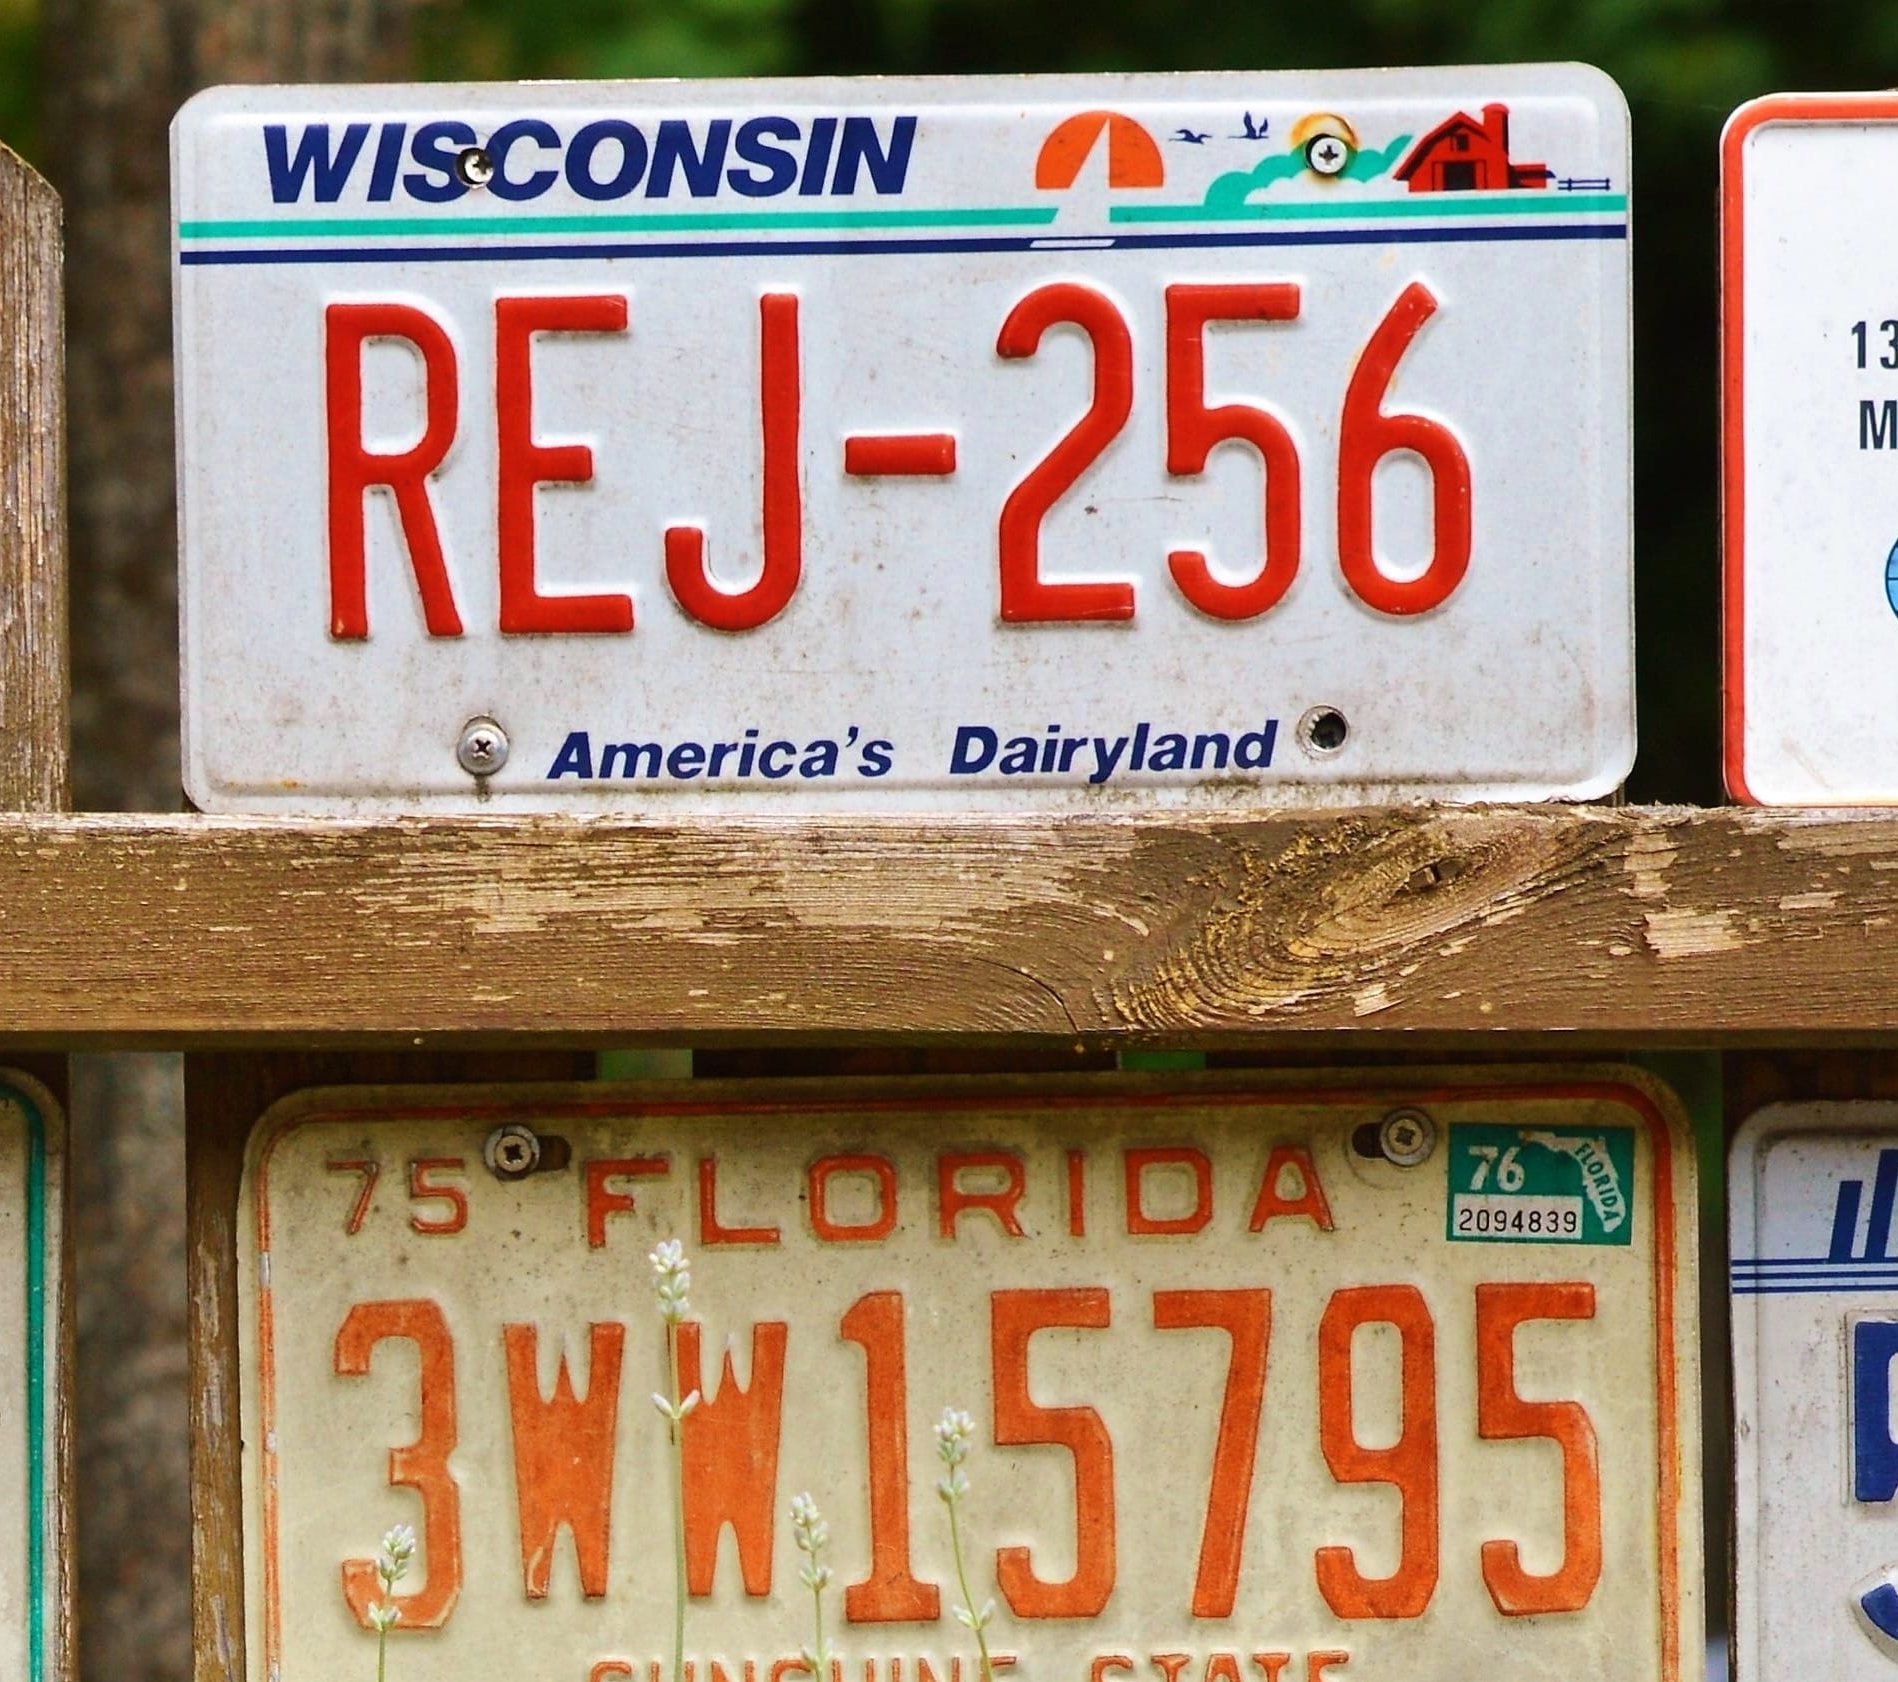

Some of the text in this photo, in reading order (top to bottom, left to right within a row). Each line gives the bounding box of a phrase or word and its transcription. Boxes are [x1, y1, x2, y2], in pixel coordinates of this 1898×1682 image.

[264, 116, 917, 203] WISCONSIN
[325, 281, 1472, 640] REJ-256
[548, 718, 1277, 783] America's Dairyland
[324, 1146, 1336, 1247] 75 FLORIDA
[1469, 1146, 1525, 1192] 76
[1575, 1141, 1620, 1222] FLORIDA
[1459, 1208, 1577, 1233] 2094839
[334, 1281, 1603, 1631] 3WW15795
